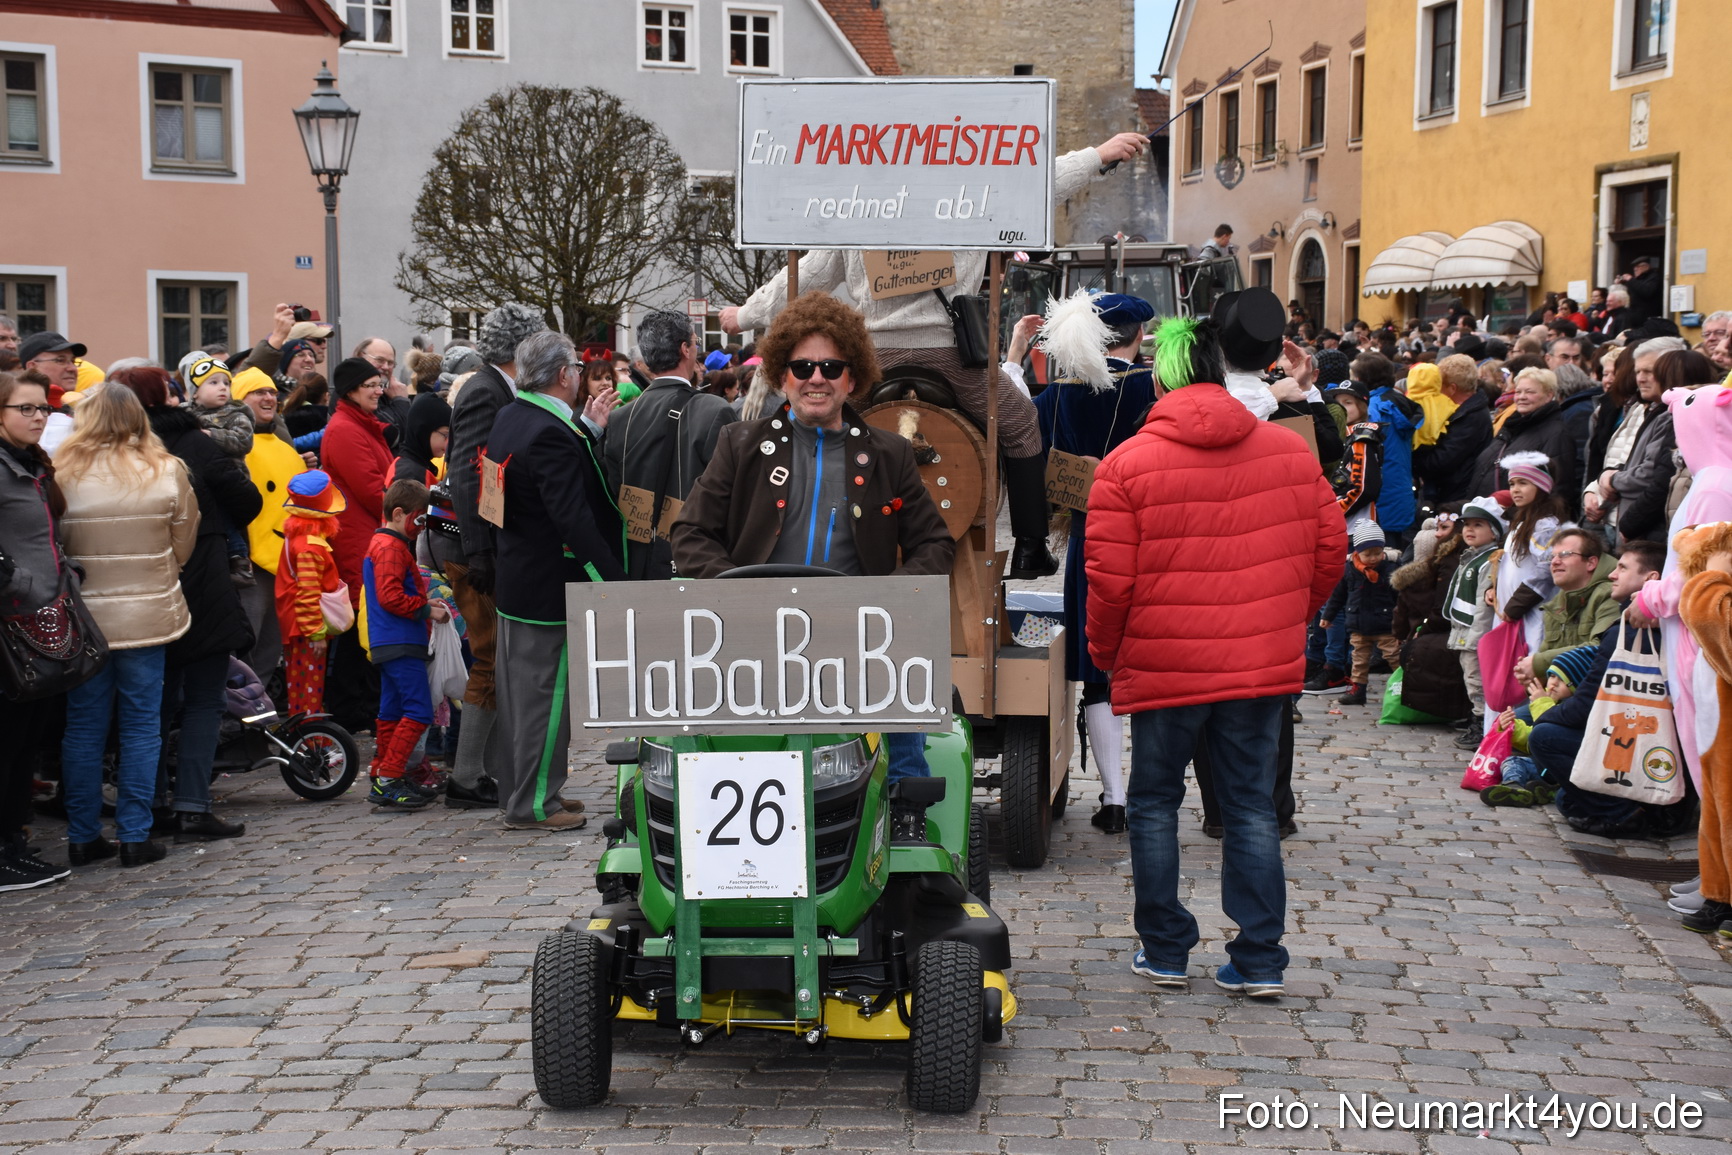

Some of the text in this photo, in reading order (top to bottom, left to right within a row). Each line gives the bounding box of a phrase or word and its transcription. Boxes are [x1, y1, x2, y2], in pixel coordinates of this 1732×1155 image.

[748, 129, 788, 165] Ein
[804, 184, 991, 220] rechnet ab!
[999, 229, 1027, 244] ugu.
[874, 265, 955, 293] Guttenberger
[1057, 467, 1085, 493] Georg
[621, 487, 645, 506] Bgm.
[1604, 673, 1666, 696] Plus
[706, 778, 786, 847] 26
